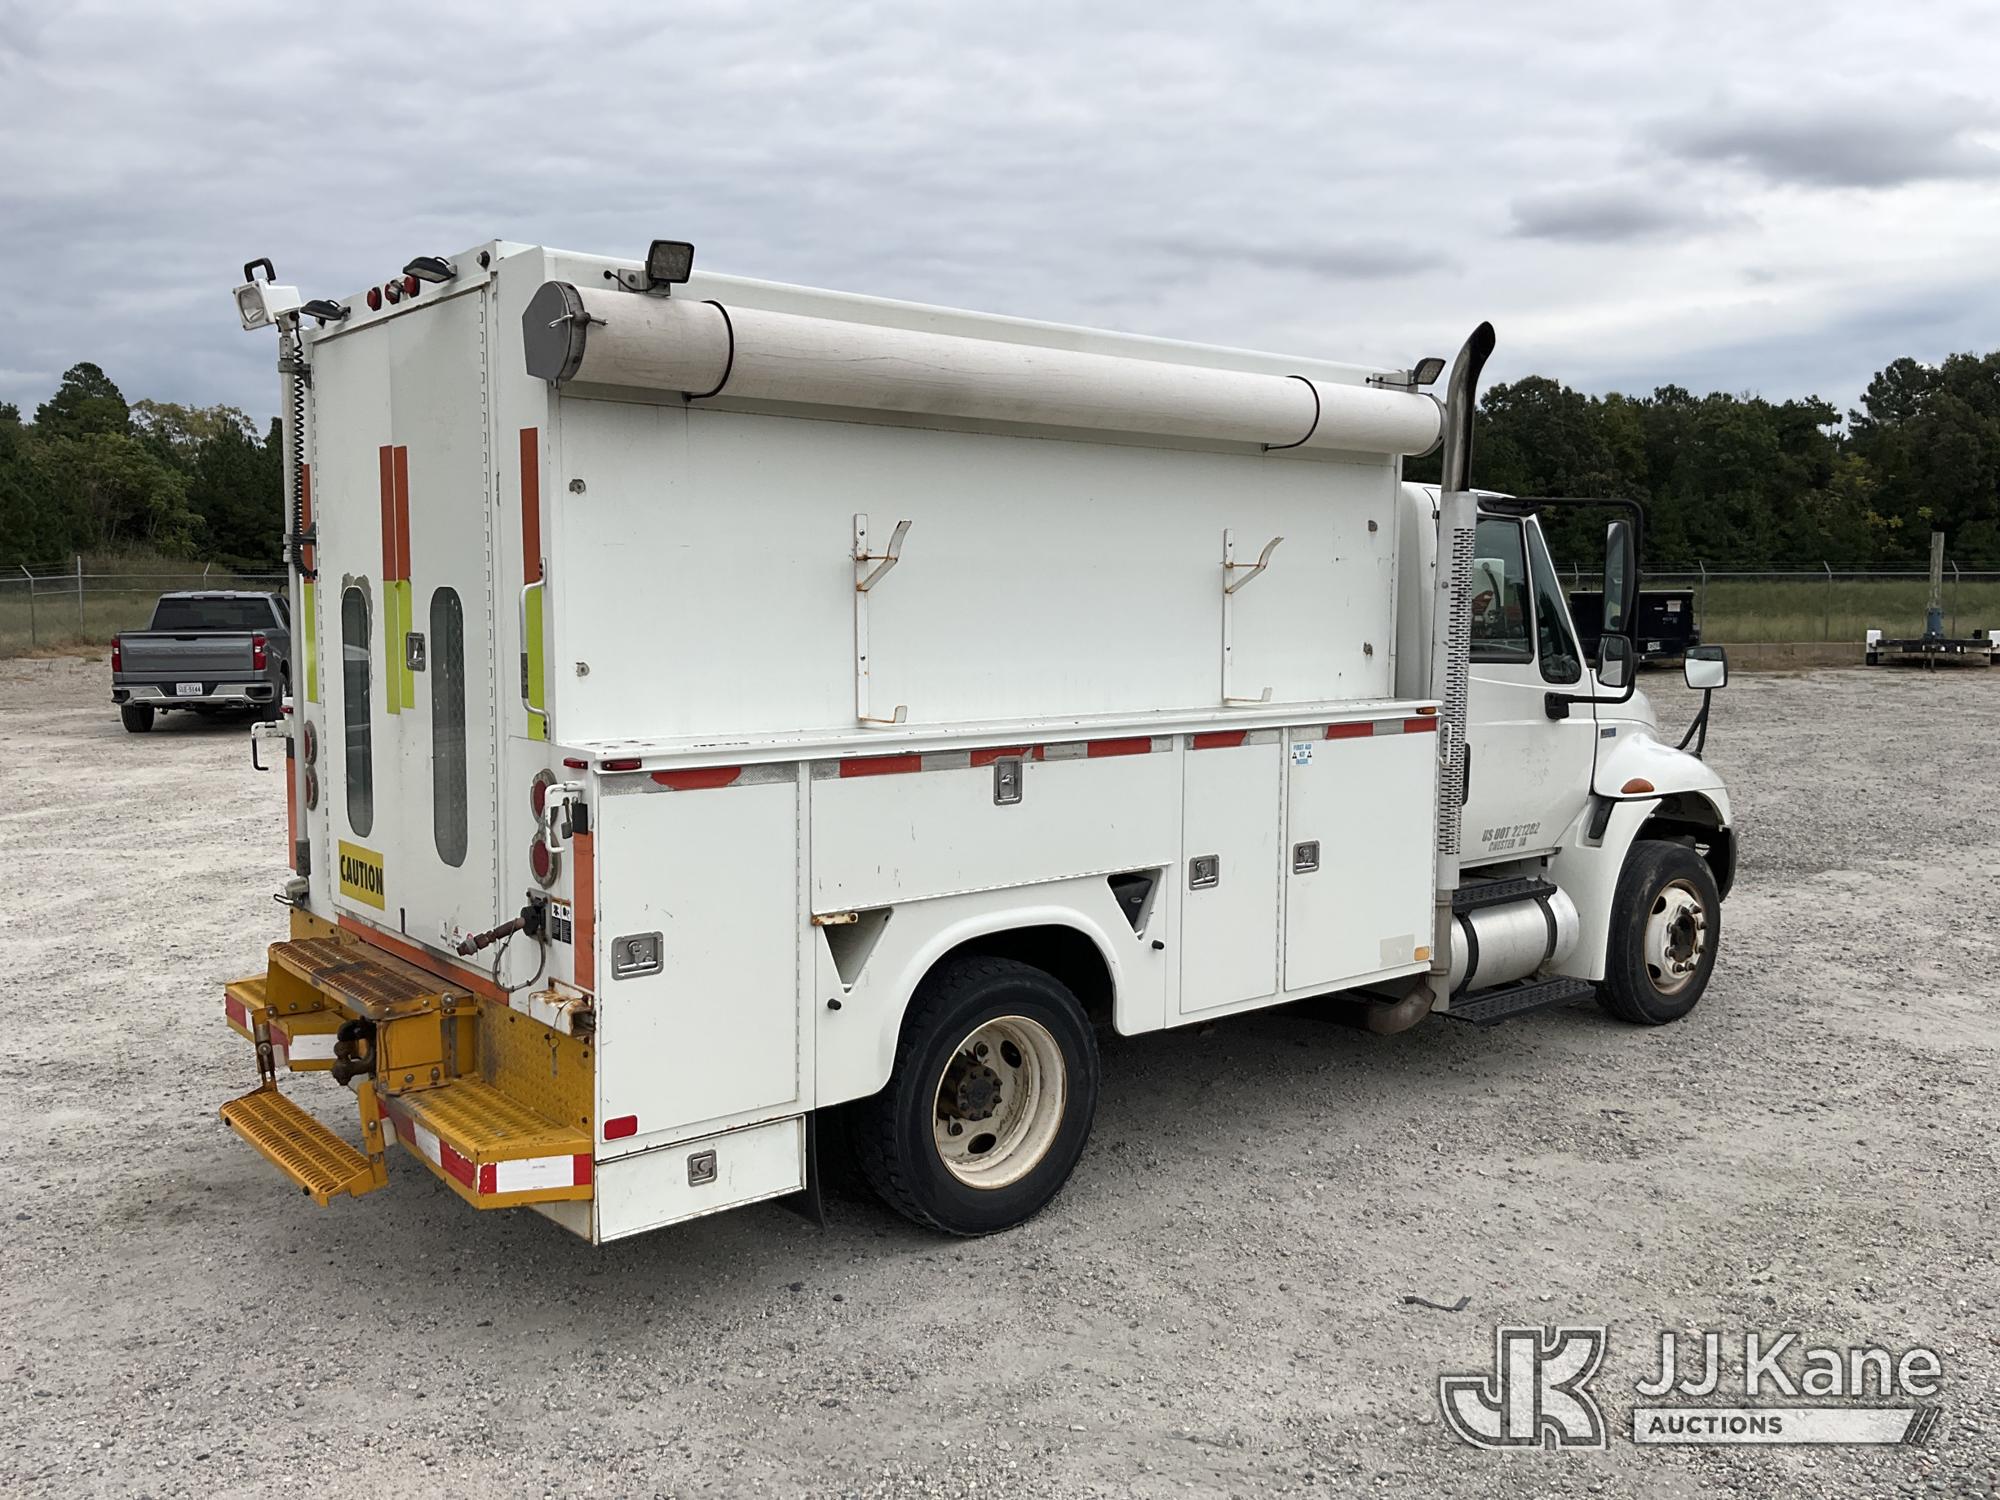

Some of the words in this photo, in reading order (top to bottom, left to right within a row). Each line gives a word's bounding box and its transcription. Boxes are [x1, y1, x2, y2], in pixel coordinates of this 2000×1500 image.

[1482, 829, 1494, 842] US
[1494, 827, 1511, 840] DOT
[340, 854, 383, 896] CAUTION
